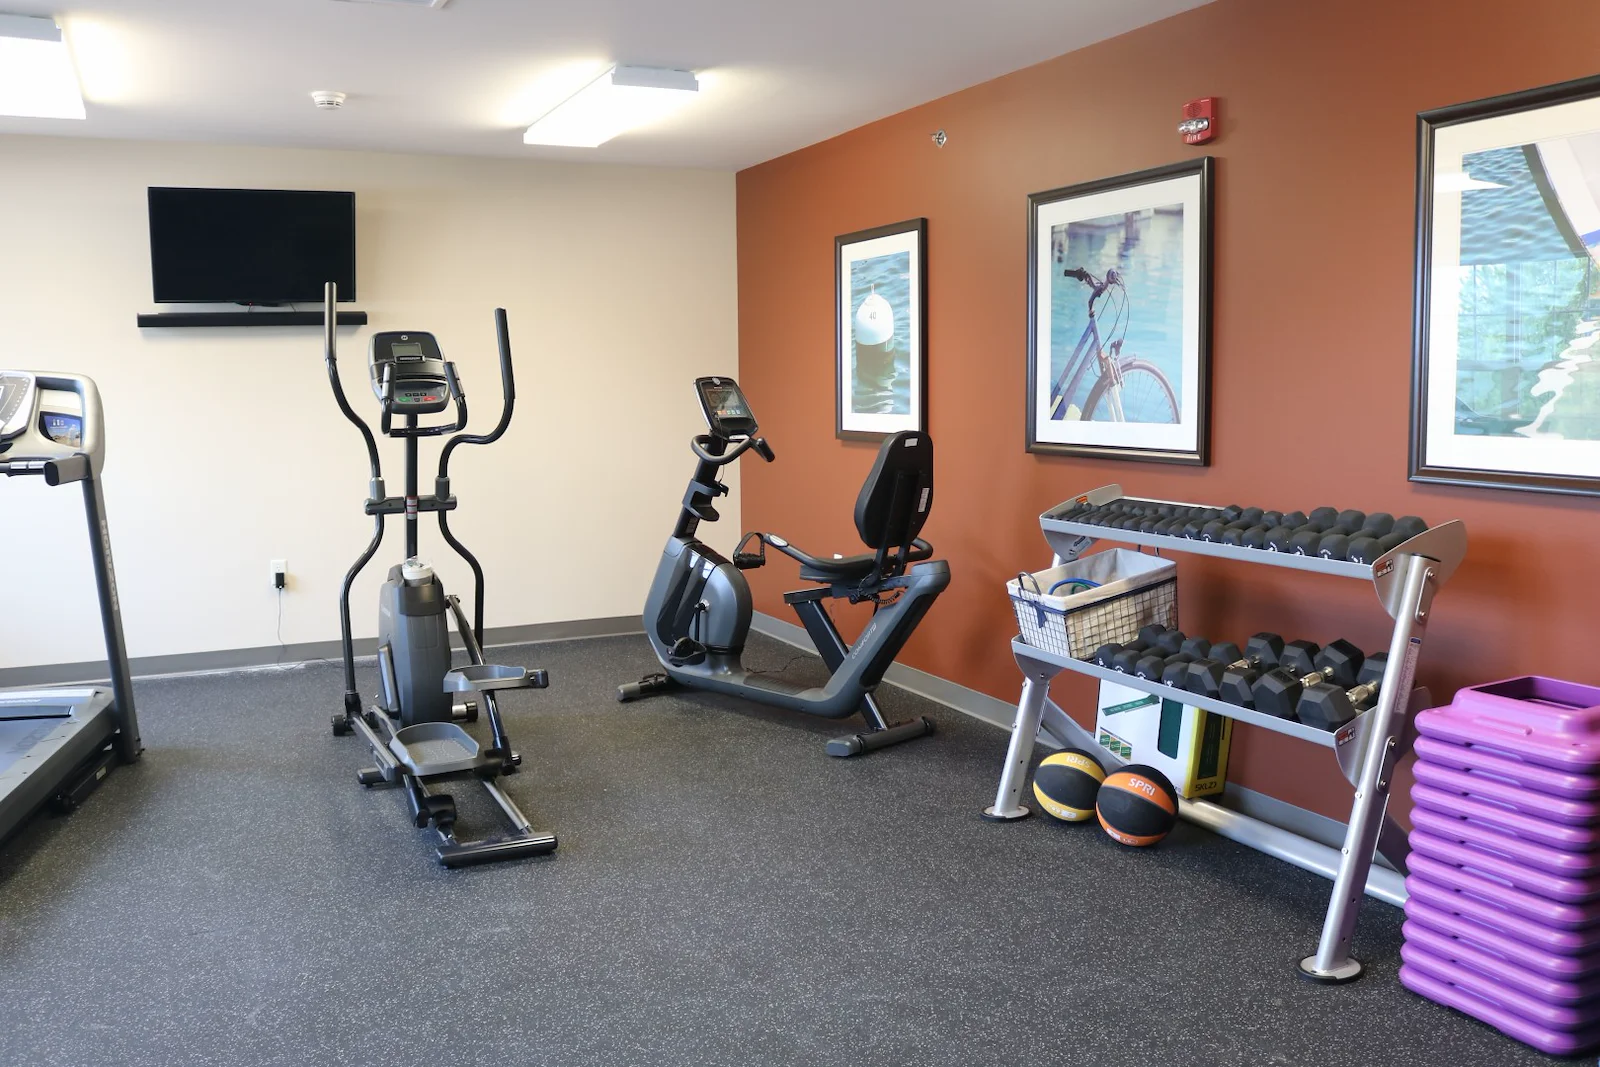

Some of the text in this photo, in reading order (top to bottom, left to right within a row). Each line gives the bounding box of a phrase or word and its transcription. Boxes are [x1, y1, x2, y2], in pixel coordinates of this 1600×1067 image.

[1186, 133, 1202, 143] FIRE
[869, 311, 877, 320] 40
[101, 519, 119, 611] HORIZON
[1129, 777, 1156, 796] SPRI
